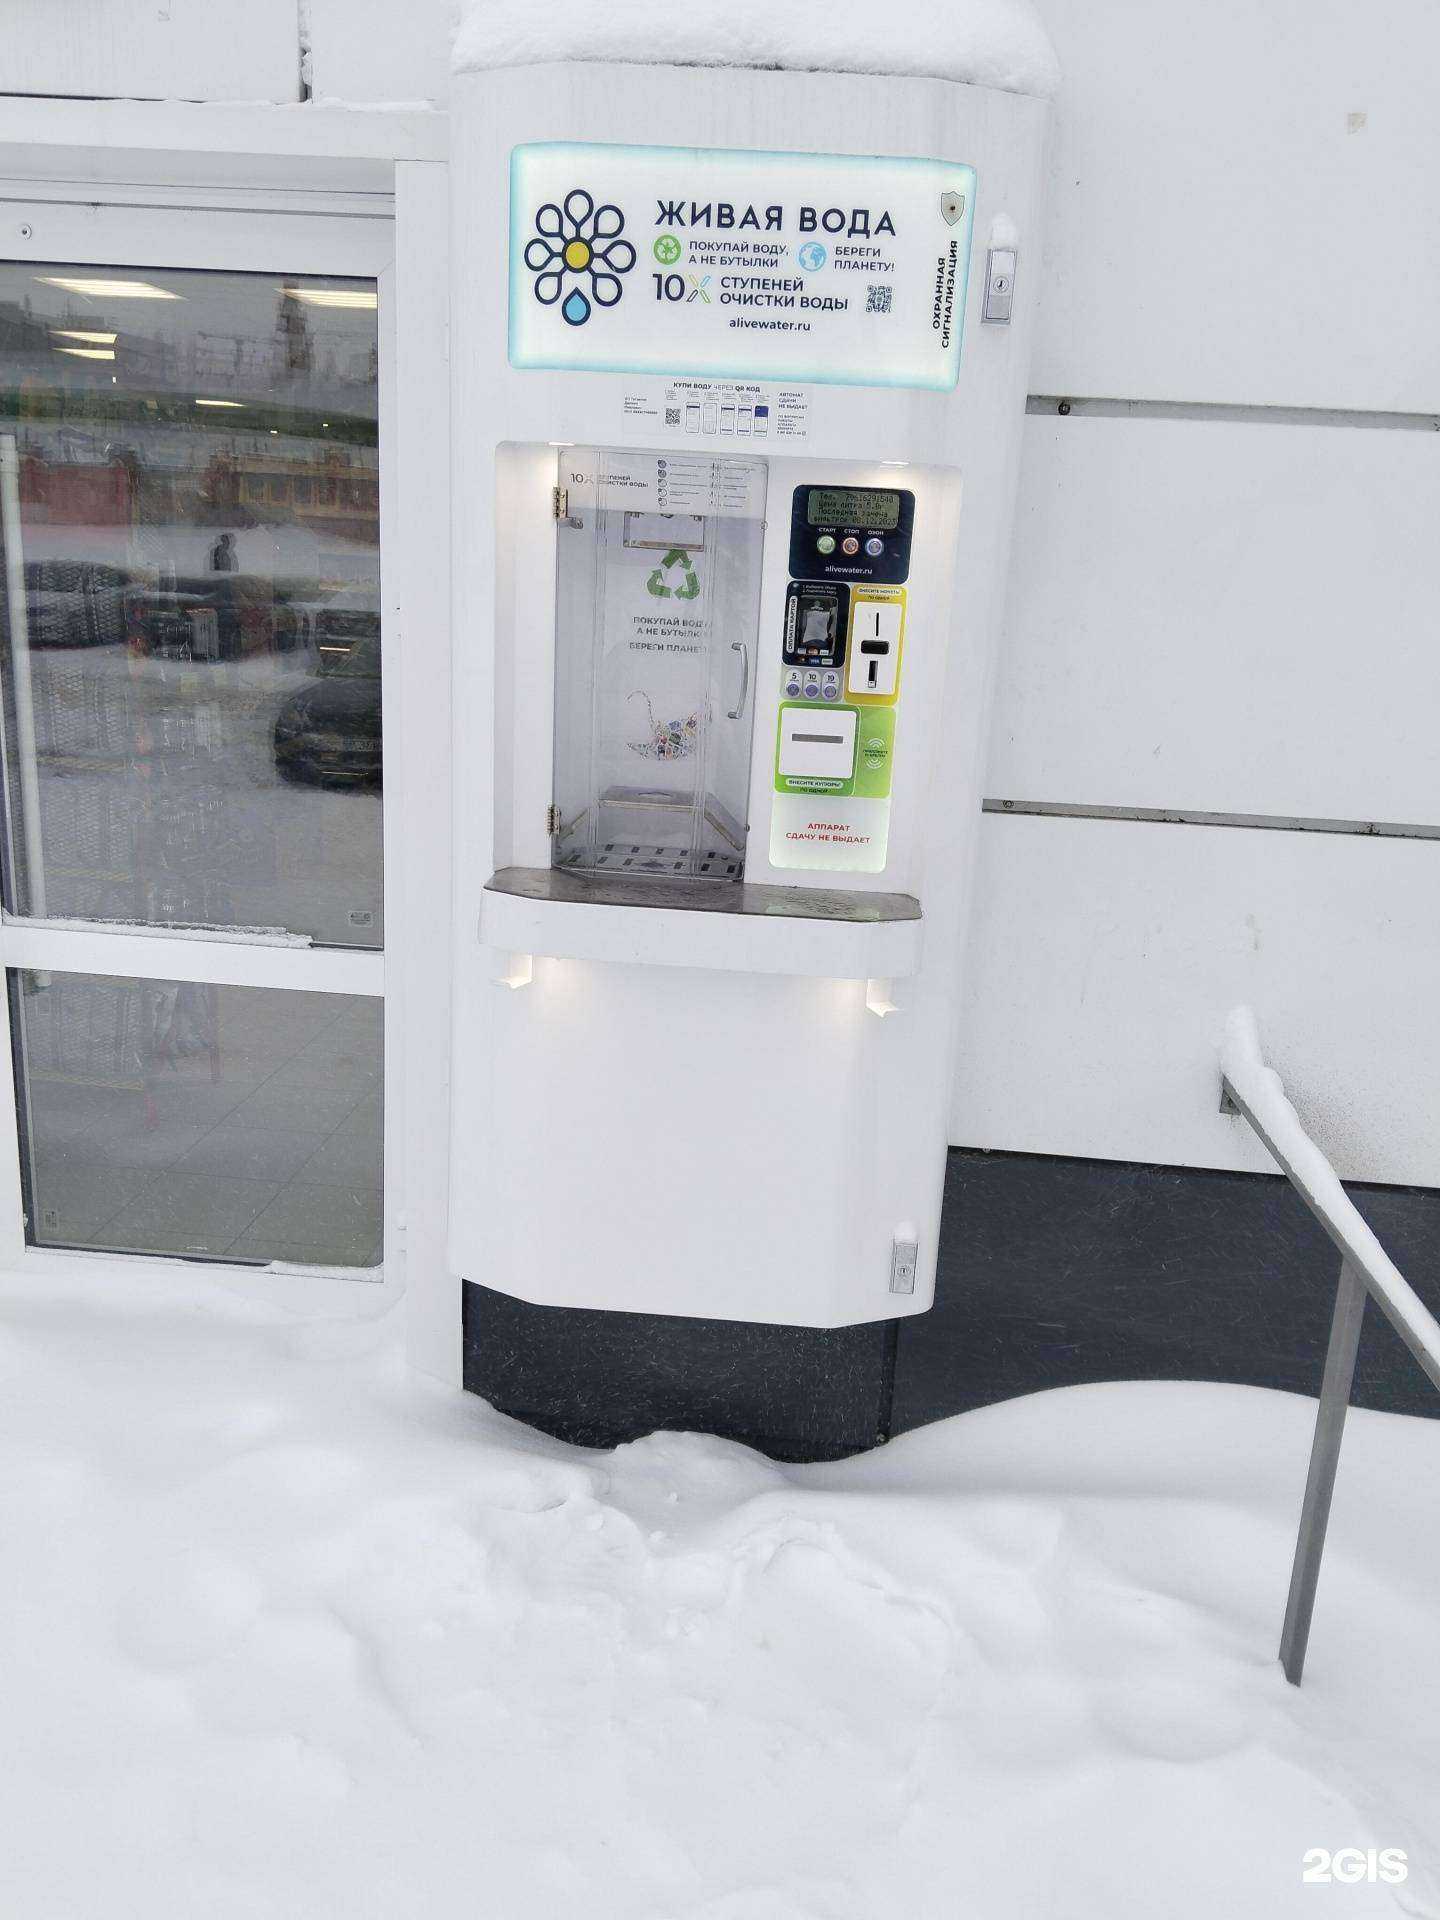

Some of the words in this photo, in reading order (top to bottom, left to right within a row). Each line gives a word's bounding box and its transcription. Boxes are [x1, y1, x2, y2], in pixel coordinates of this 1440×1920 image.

[654, 200, 783, 231] ЖИВАЯ
[799, 207, 896, 239] ВОДА
[689, 240, 749, 253] ПОКУПАЙ
[753, 244, 789, 256] ВОДУ,
[835, 246, 881, 258] БЕРЕГИ
[688, 255, 698, 265] А
[700, 255, 717, 265] НЕ
[720, 256, 779, 268] БУТЫЛКИ
[834, 260, 895, 272] ПЛАНЕТУ!
[720, 276, 804, 292] СТУПЕНЕЙ
[932, 257, 946, 330] ОХРАННАЯ
[942, 240, 958, 349] СИГНАЛИЗАЦИЯ
[720, 293, 795, 308] ОЧИСТКИ
[800, 296, 849, 311] ВОДЫ
[729, 317, 811, 332] alivewater.ru
[673, 382, 692, 390] КУПИ
[693, 383, 713, 391] ВОДУ
[825, 565, 873, 575] alivewater.ru
[633, 616, 680, 626] ПОКУПАЙ
[637, 627, 644, 635] А
[646, 627, 659, 636] НЕ
[629, 642, 664, 652] БЕРЕГИ
[807, 823, 851, 832] АППАРАТ
[785, 832, 816, 840] СДАЧУ
[818, 834, 830, 842] НЕ
[832, 835, 870, 844] ВЫДАЕТ
